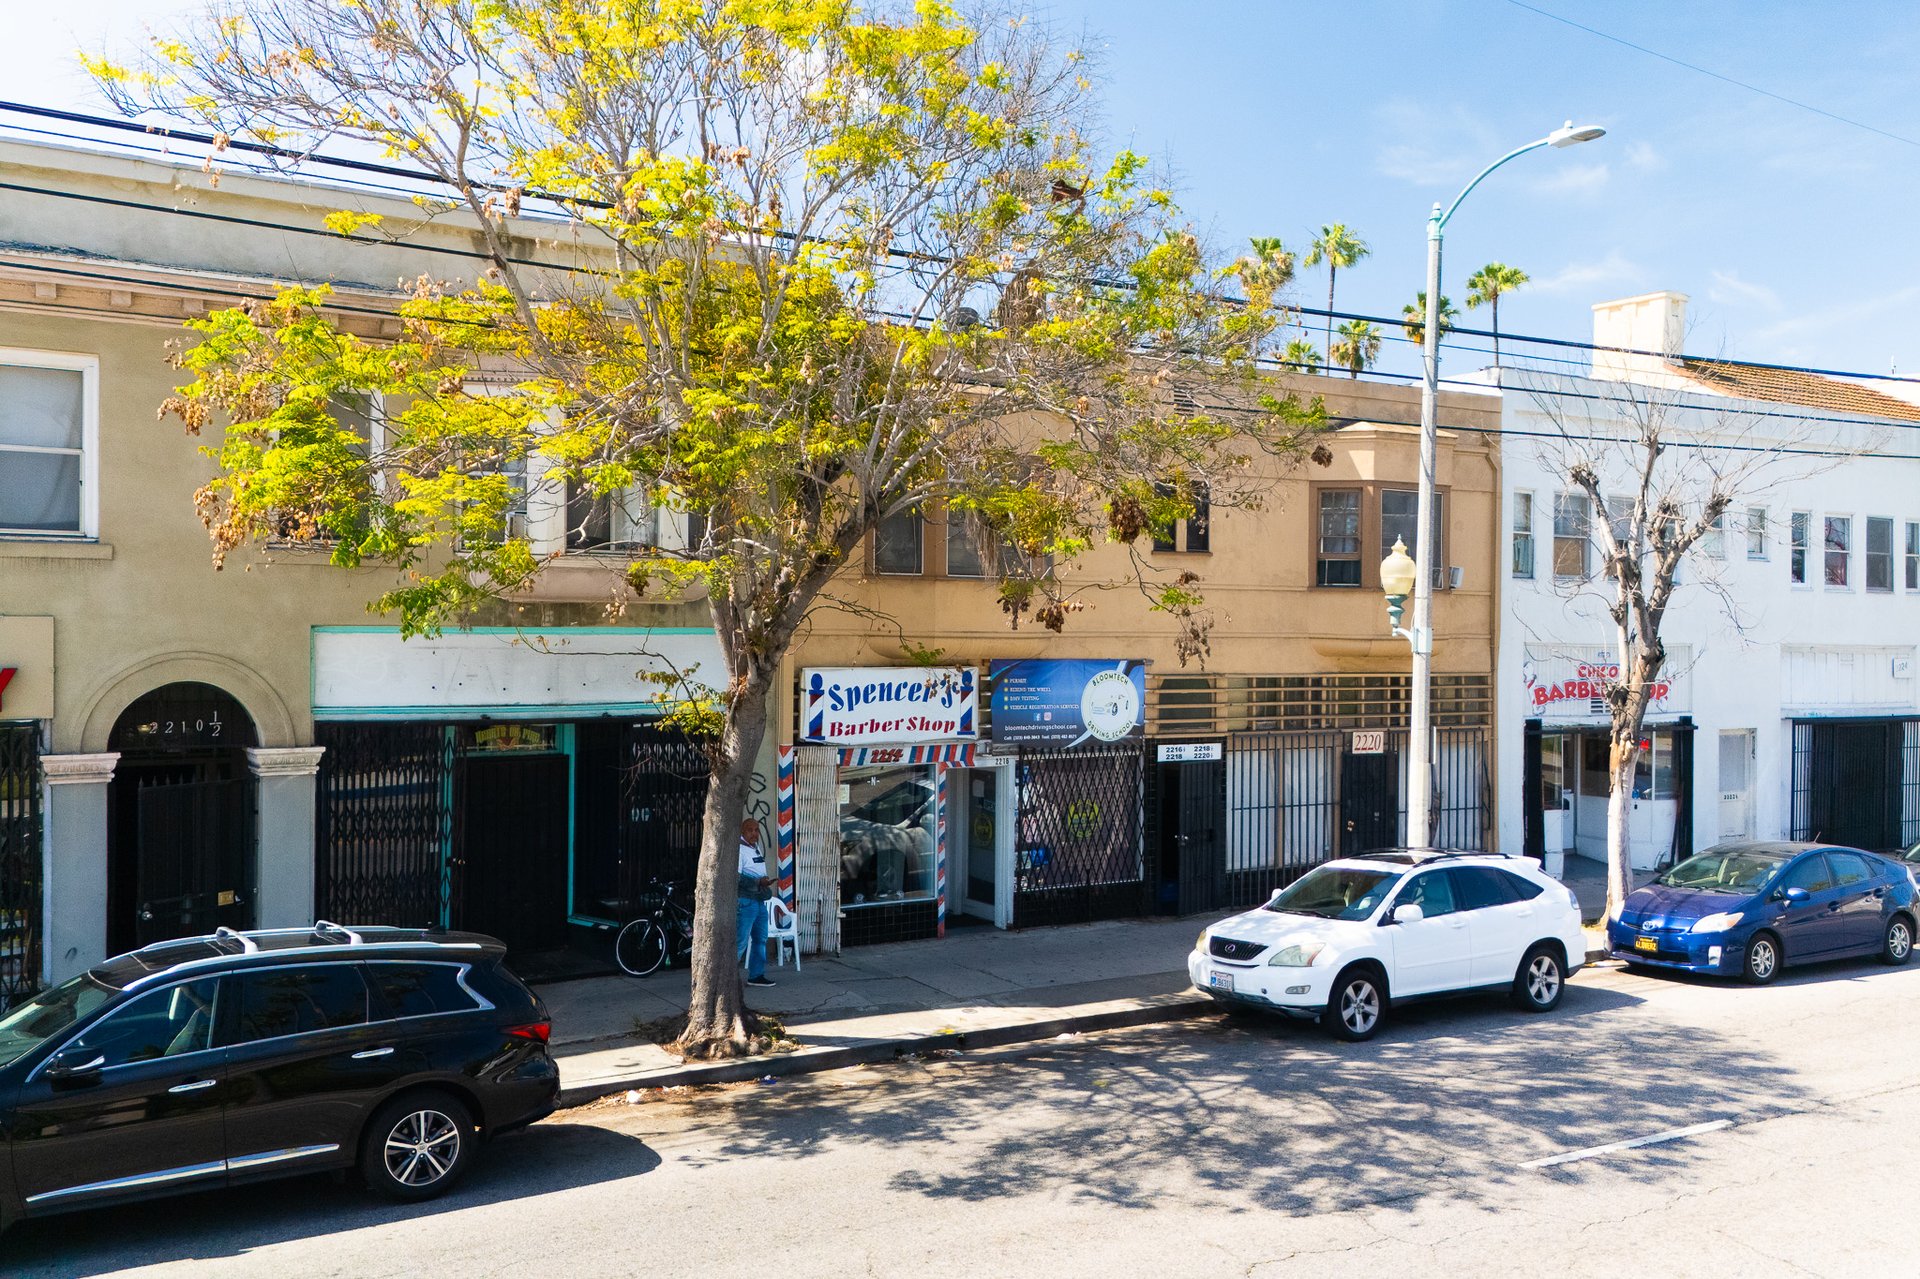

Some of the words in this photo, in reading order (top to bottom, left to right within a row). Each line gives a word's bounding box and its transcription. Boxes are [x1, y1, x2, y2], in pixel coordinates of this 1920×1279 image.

[1091, 673, 1129, 687] BLOOMTECH
[829, 718, 904, 737] Barber
[906, 716, 955, 734] Shop
[1087, 720, 1110, 739] DRIVING
[1112, 720, 1133, 739] SCHOOL
[1354, 734, 1382, 751] 2220
[995, 757, 1010, 765] 2216
